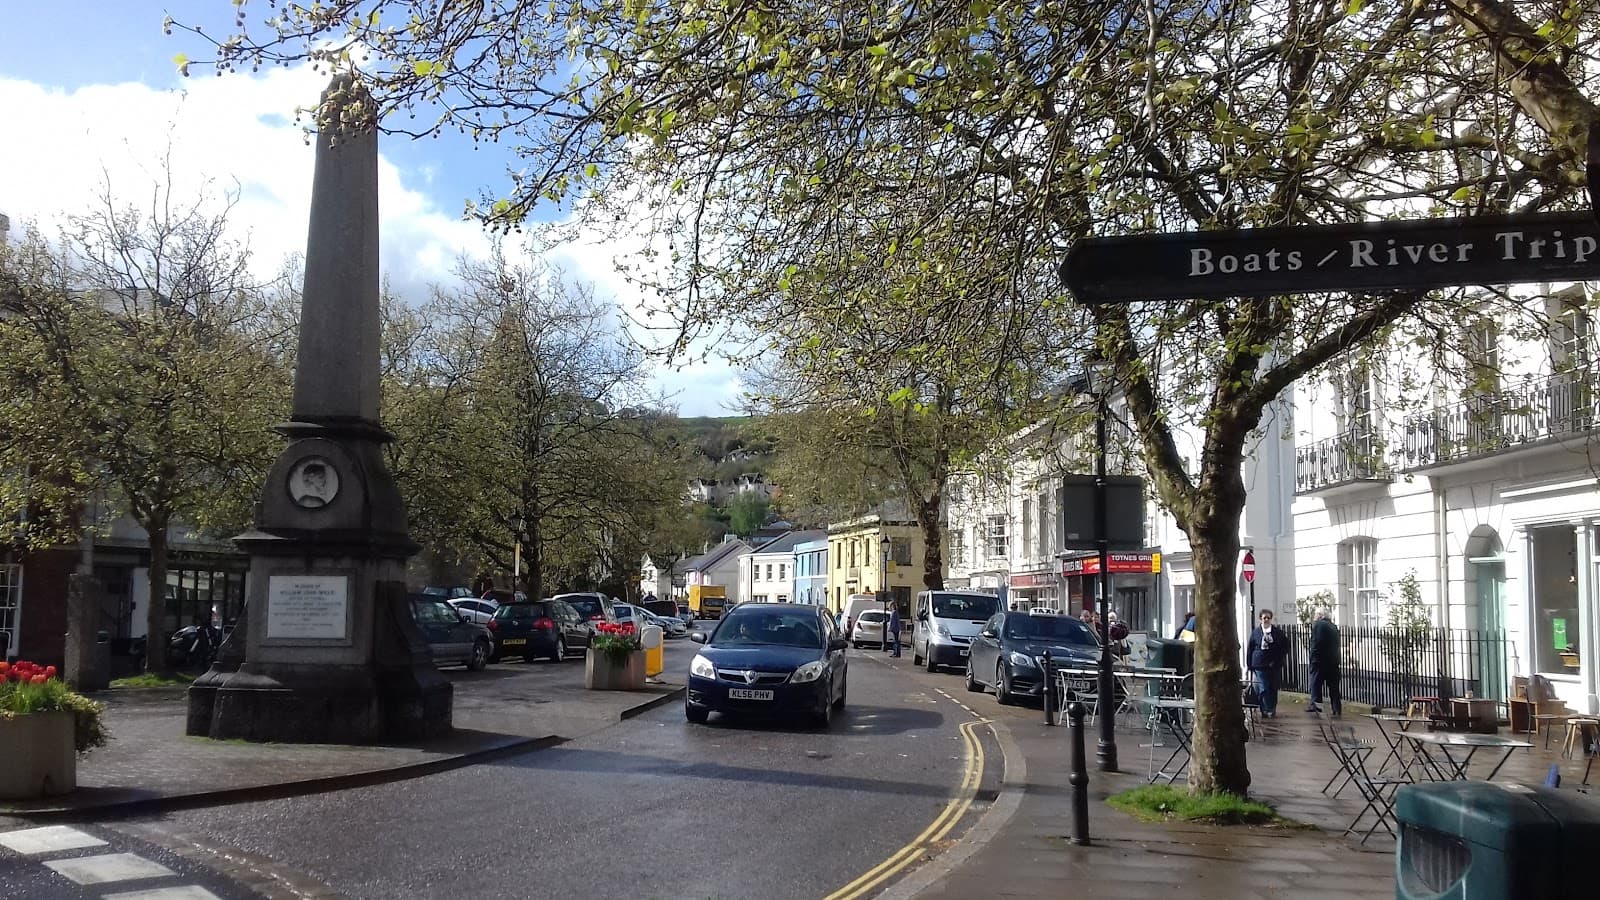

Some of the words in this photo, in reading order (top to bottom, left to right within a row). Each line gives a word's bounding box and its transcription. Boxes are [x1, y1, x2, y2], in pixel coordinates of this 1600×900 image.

[1188, 247, 1303, 277] Boats
[1349, 238, 1474, 269] River
[1495, 230, 1597, 264] Trip
[754, 690, 770, 699] PHV
